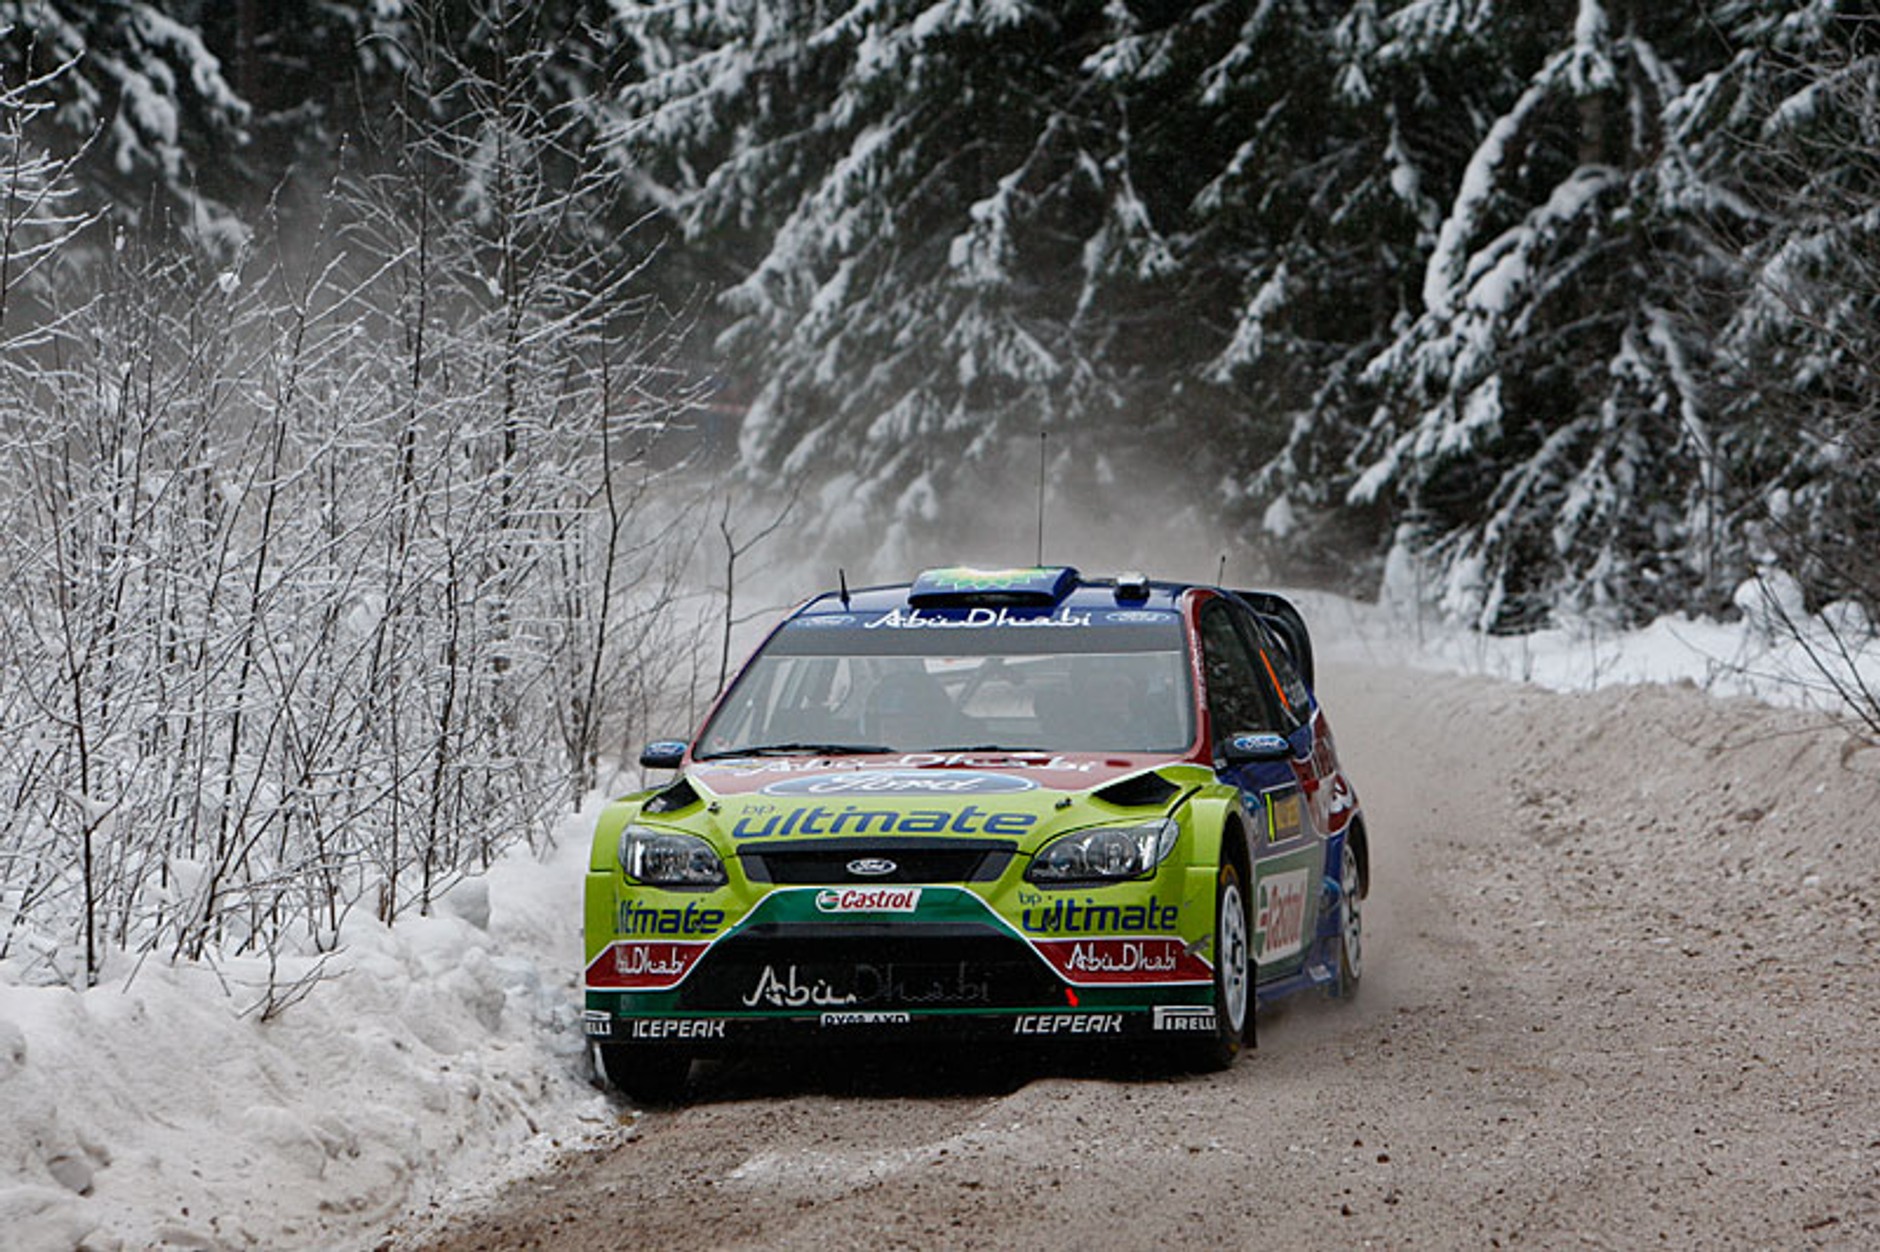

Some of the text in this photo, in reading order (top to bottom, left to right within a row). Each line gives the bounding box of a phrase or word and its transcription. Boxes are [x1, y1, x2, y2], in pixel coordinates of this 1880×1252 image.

[864, 608, 1092, 628] Abu Dhabi
[808, 774, 988, 793] Ford
[733, 805, 1039, 838] ultimate
[840, 890, 914, 910] Castrol
[1018, 891, 1043, 907] bp
[1022, 897, 1178, 933] ultimate
[1064, 942, 1177, 972] Abu Dhabi
[742, 961, 991, 1006] Abu Dhabi
[1013, 1014, 1123, 1034] ICEPEAK
[1152, 1005, 1217, 1031] PIRELLI
[632, 1020, 726, 1038] ICEPEAK
